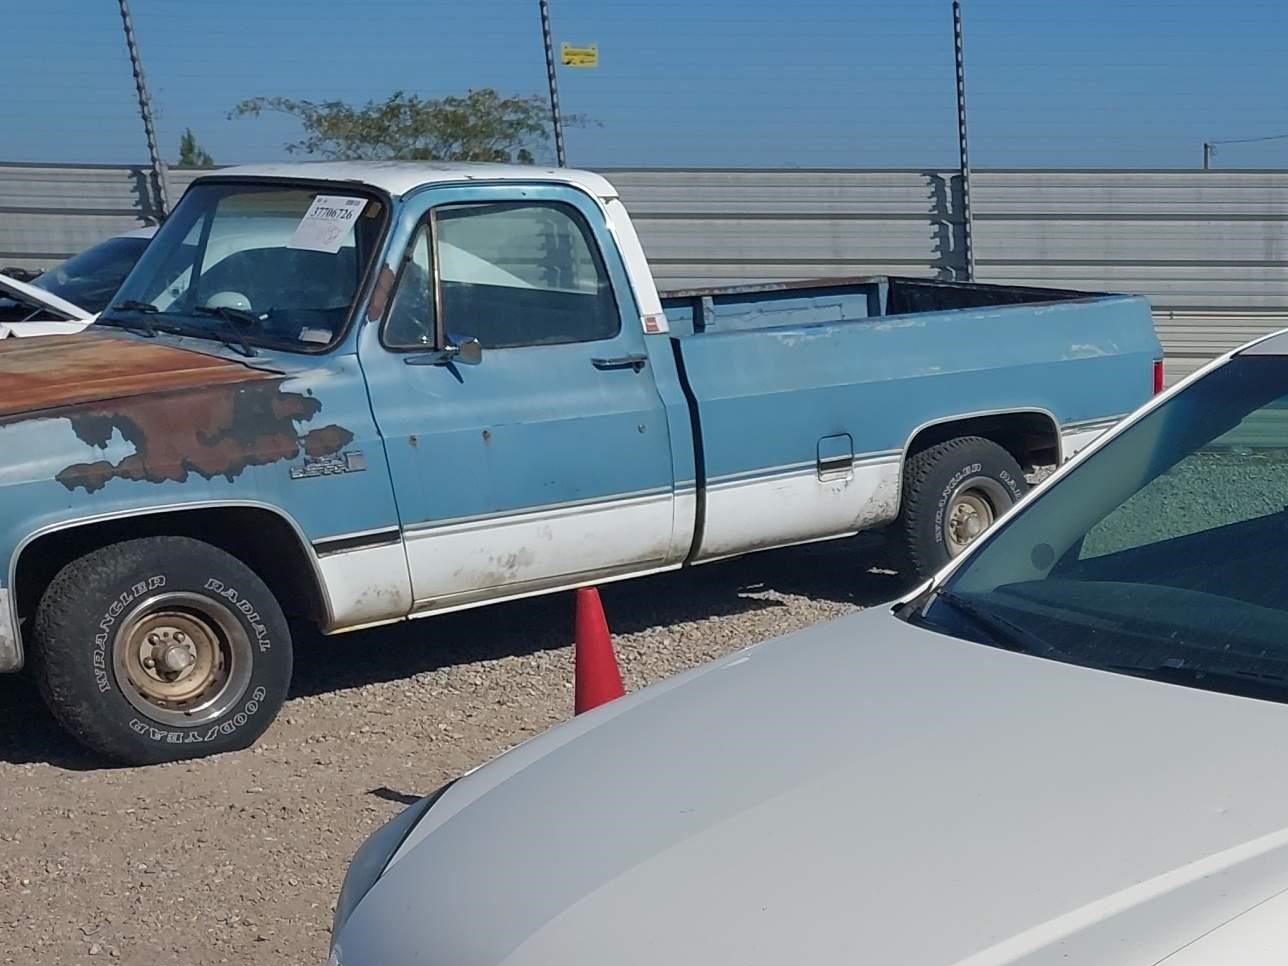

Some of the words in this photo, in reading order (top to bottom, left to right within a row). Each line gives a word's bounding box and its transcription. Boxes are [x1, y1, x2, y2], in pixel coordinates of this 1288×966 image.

[311, 206, 352, 220] 37706726
[93, 575, 166, 693] WRANGLER
[204, 578, 271, 652] RADIAL
[129, 686, 266, 743] GOODYEAR
